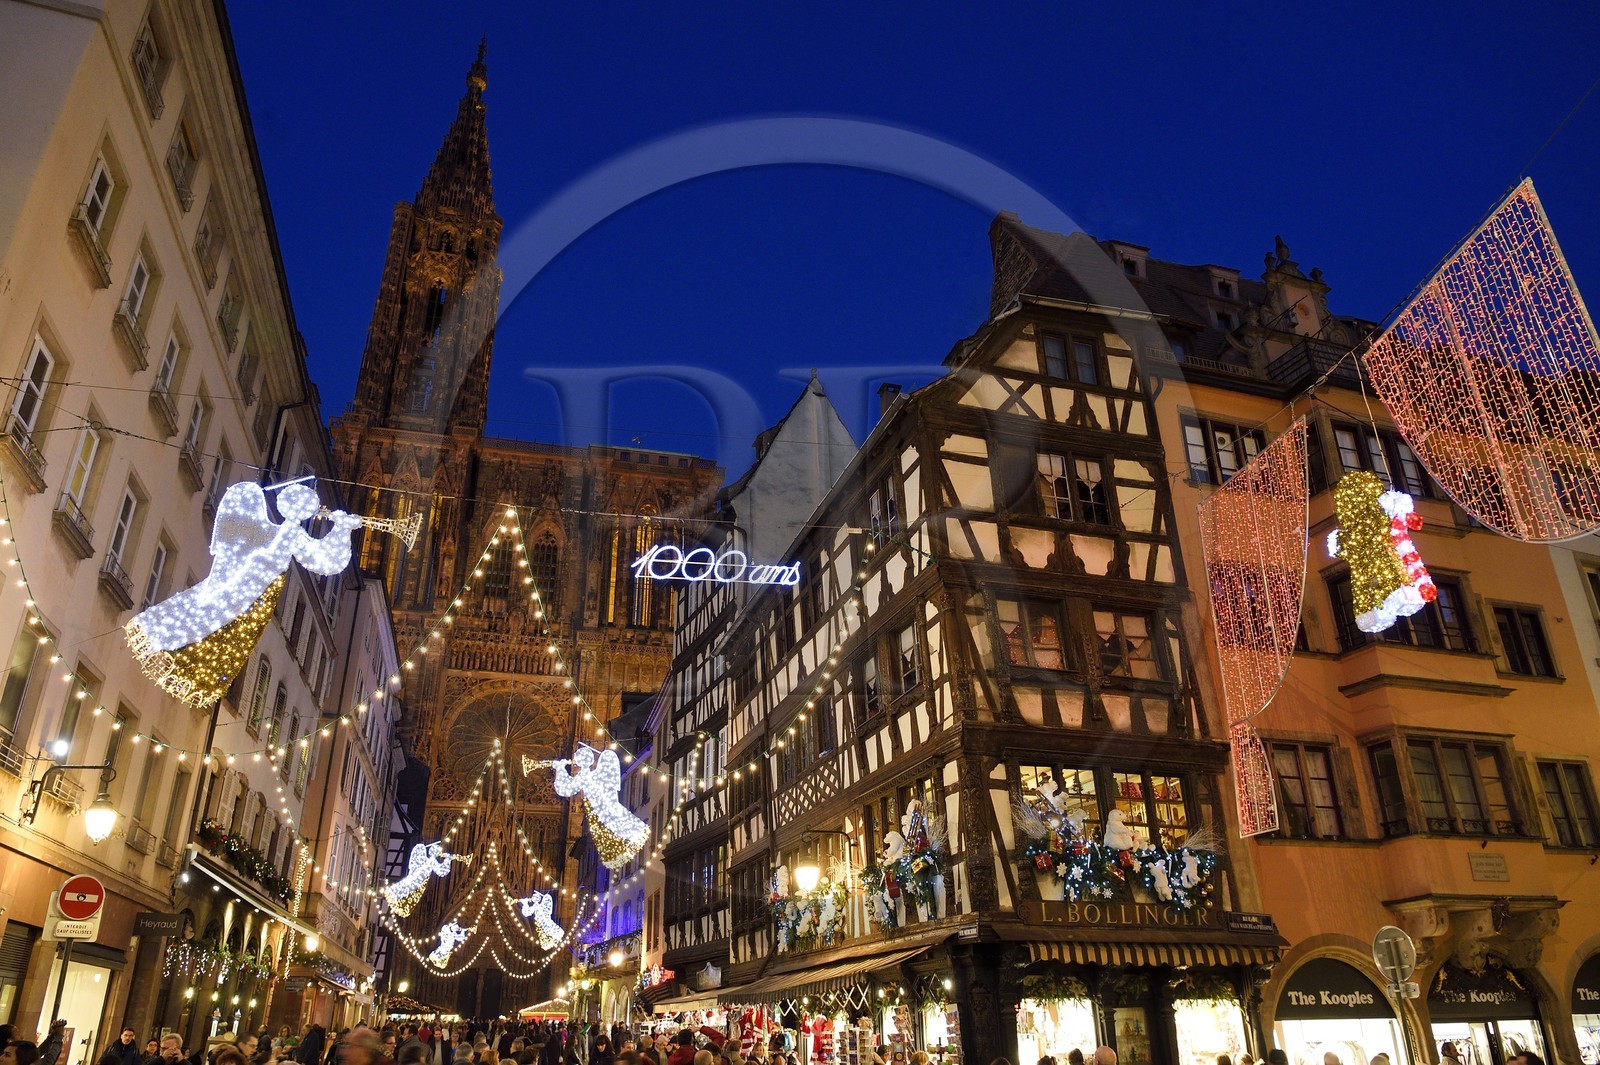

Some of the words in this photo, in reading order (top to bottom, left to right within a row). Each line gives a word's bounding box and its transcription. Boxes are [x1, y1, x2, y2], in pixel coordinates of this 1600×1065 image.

[631, 545, 747, 582] 1000
[749, 560, 801, 587] ans
[140, 918, 178, 929] Heyraud
[1288, 991, 1316, 1006] The
[1319, 990, 1374, 1008] Kooples
[1576, 988, 1600, 1001] The
